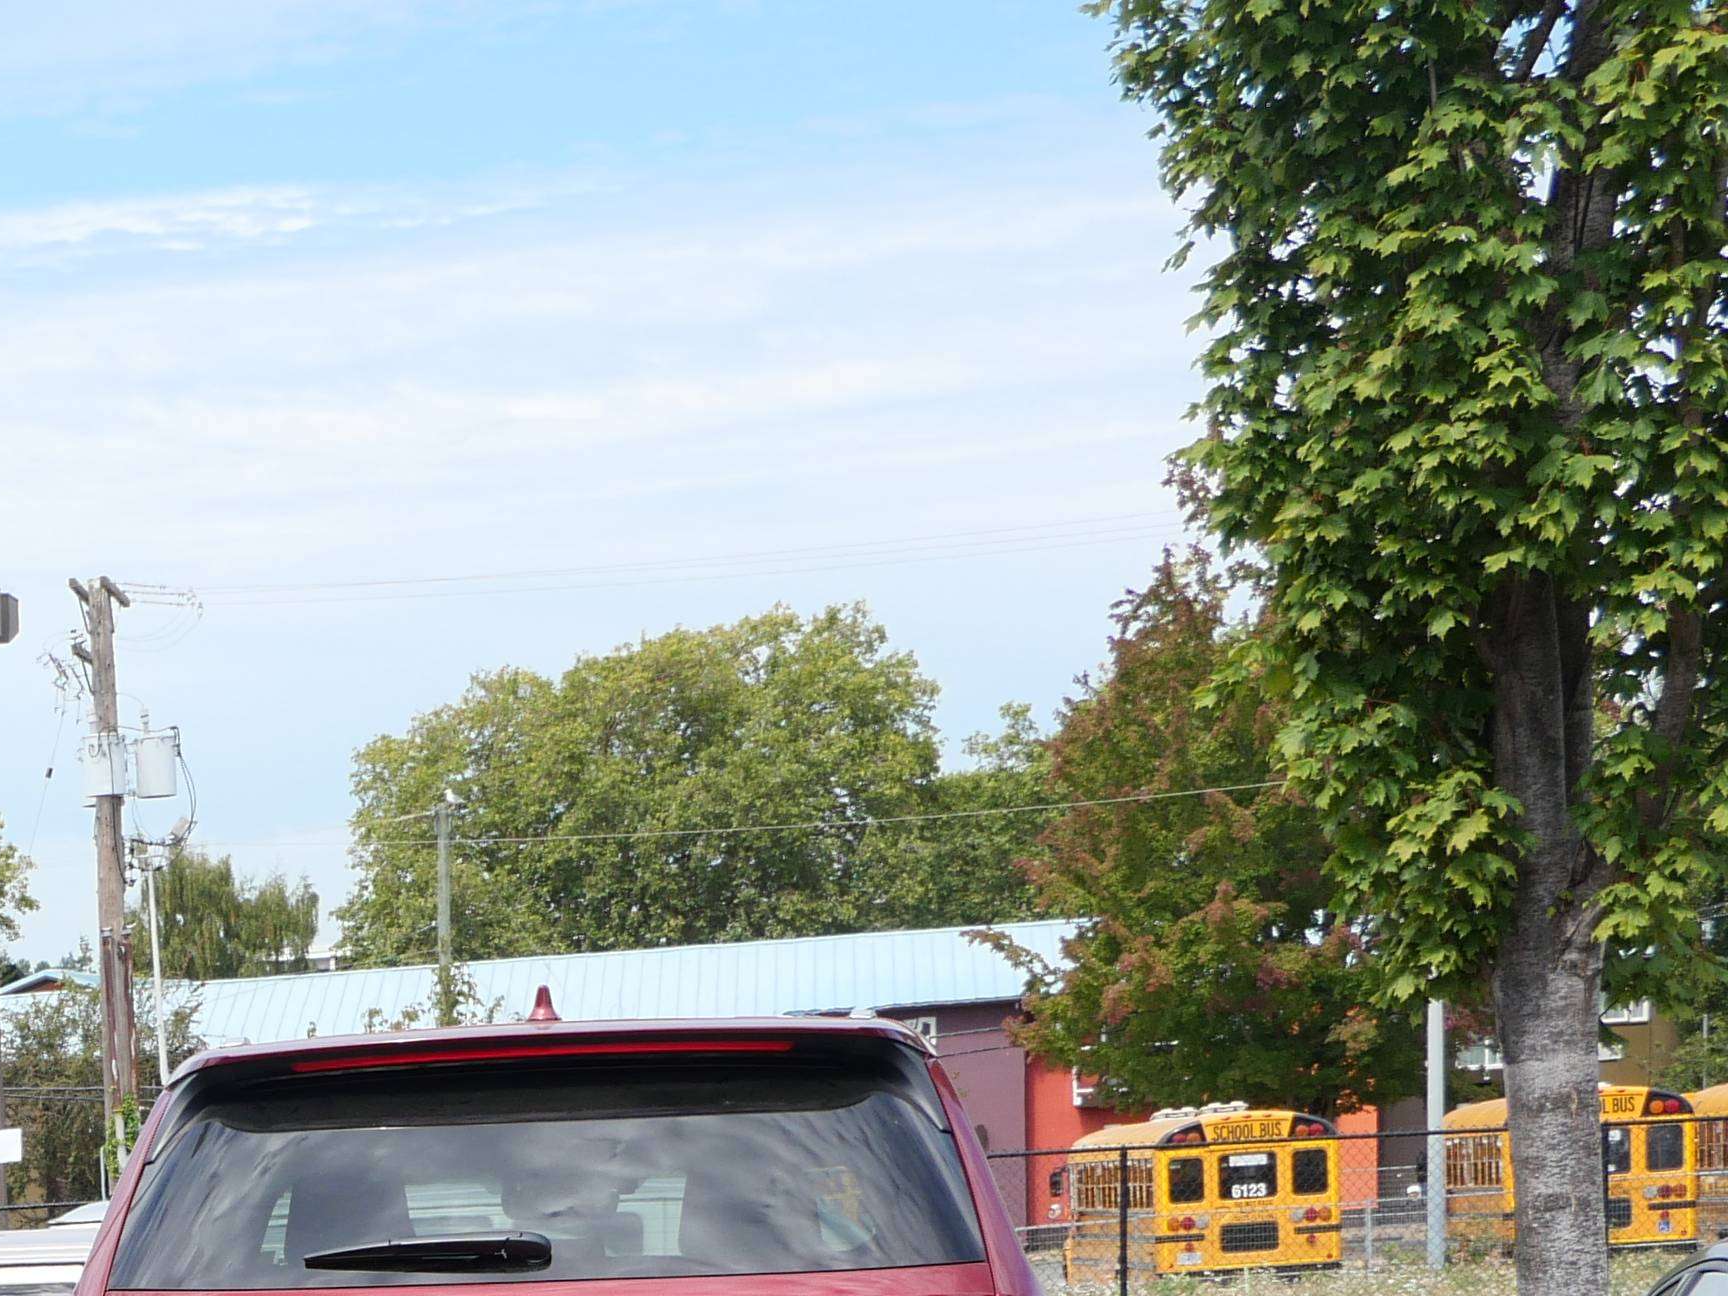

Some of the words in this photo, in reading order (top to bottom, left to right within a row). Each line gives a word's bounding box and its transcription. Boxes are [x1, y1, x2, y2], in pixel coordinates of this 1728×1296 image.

[1613, 1096, 1635, 1113] BUS
[1213, 1124, 1255, 1141] SCHOOL
[1260, 1122, 1282, 1138] BUS
[1231, 1183, 1267, 1198] 6123
